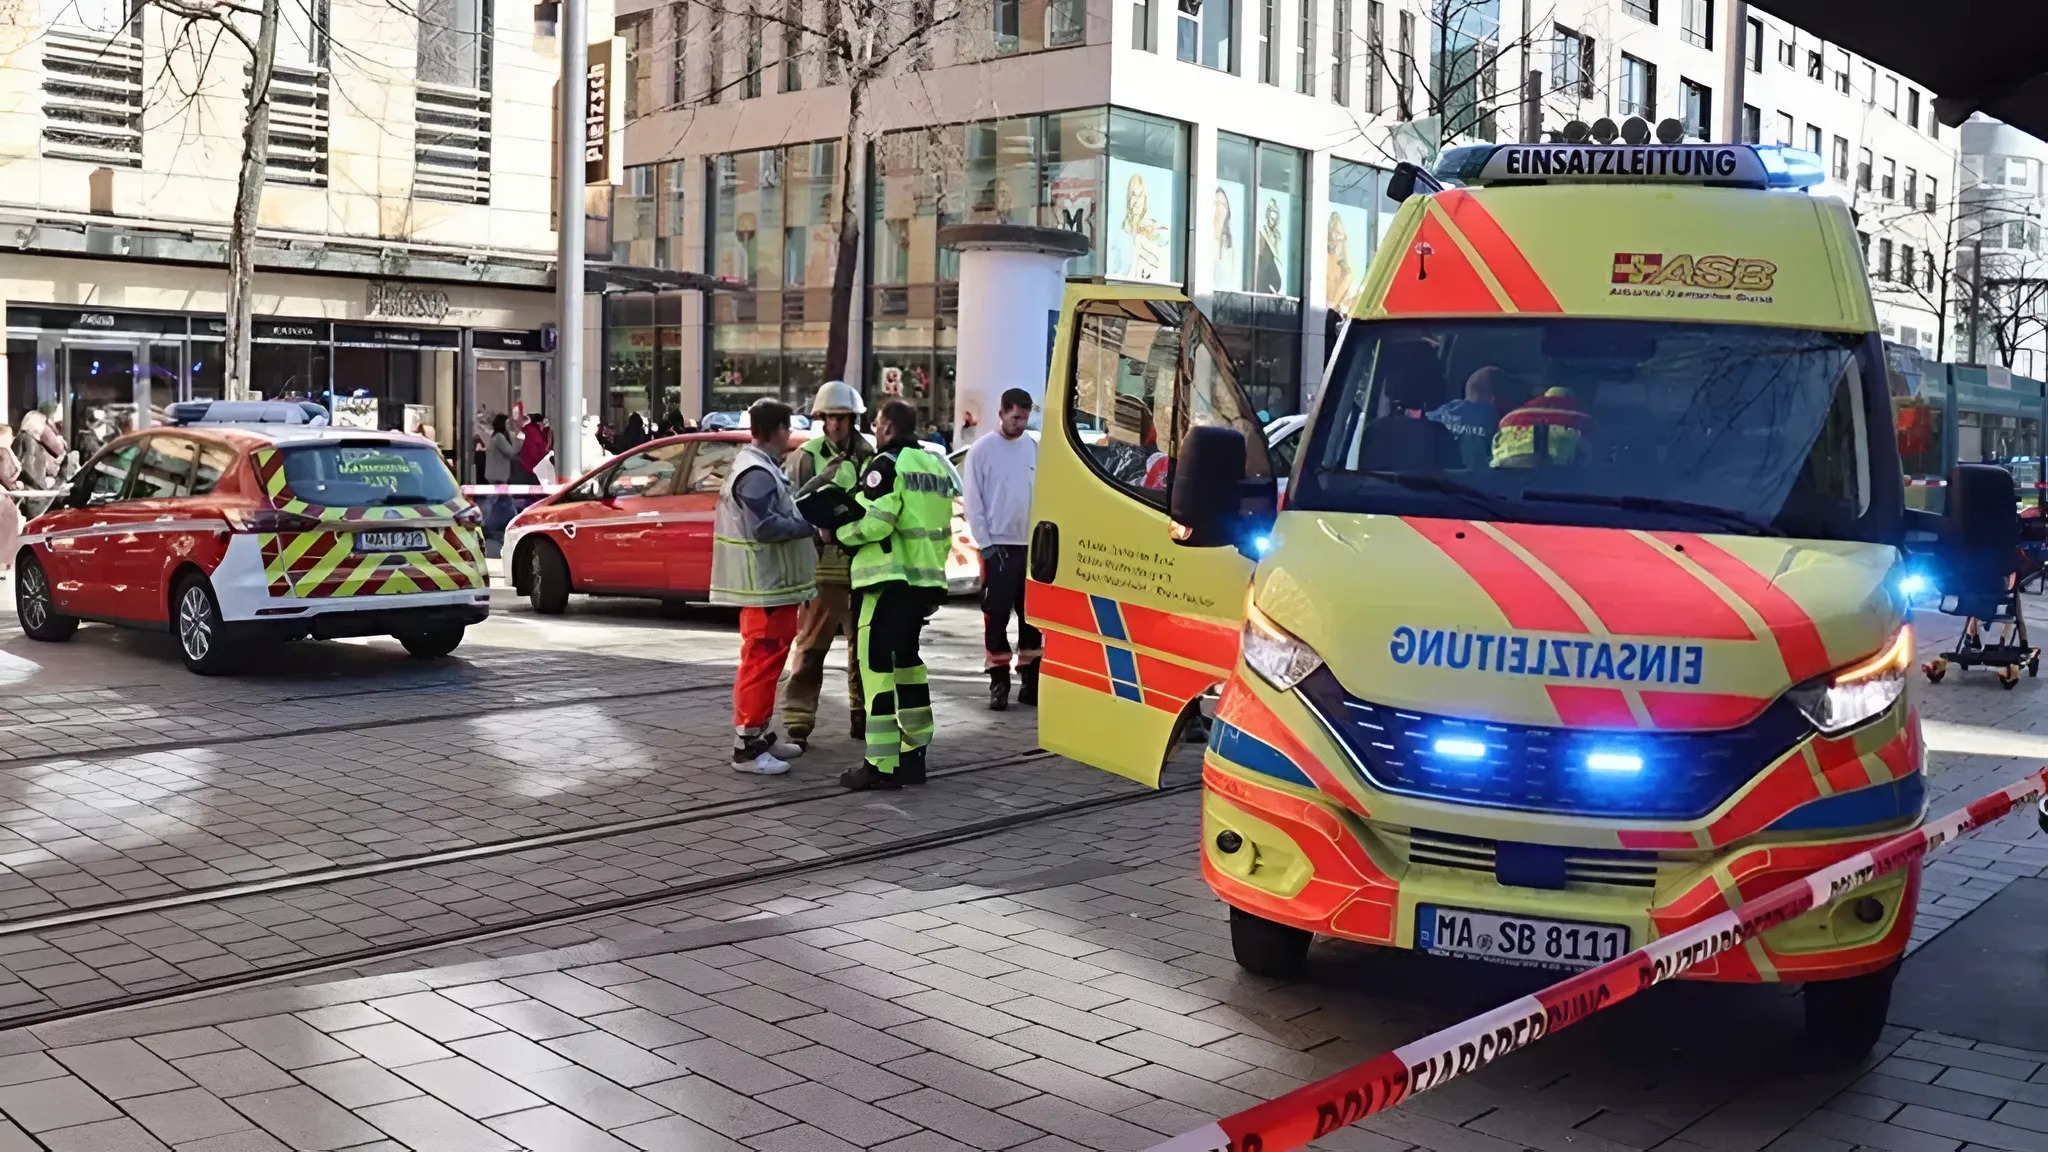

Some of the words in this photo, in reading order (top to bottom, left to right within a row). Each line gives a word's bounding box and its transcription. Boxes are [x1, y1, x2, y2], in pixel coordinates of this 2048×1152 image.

[1507, 149, 1736, 176] EINSATZLEITUNG
[1646, 254, 1777, 291] ASB
[1438, 914, 1473, 948] MA
[1498, 921, 1536, 955] SB
[1545, 926, 1618, 964] 8111
